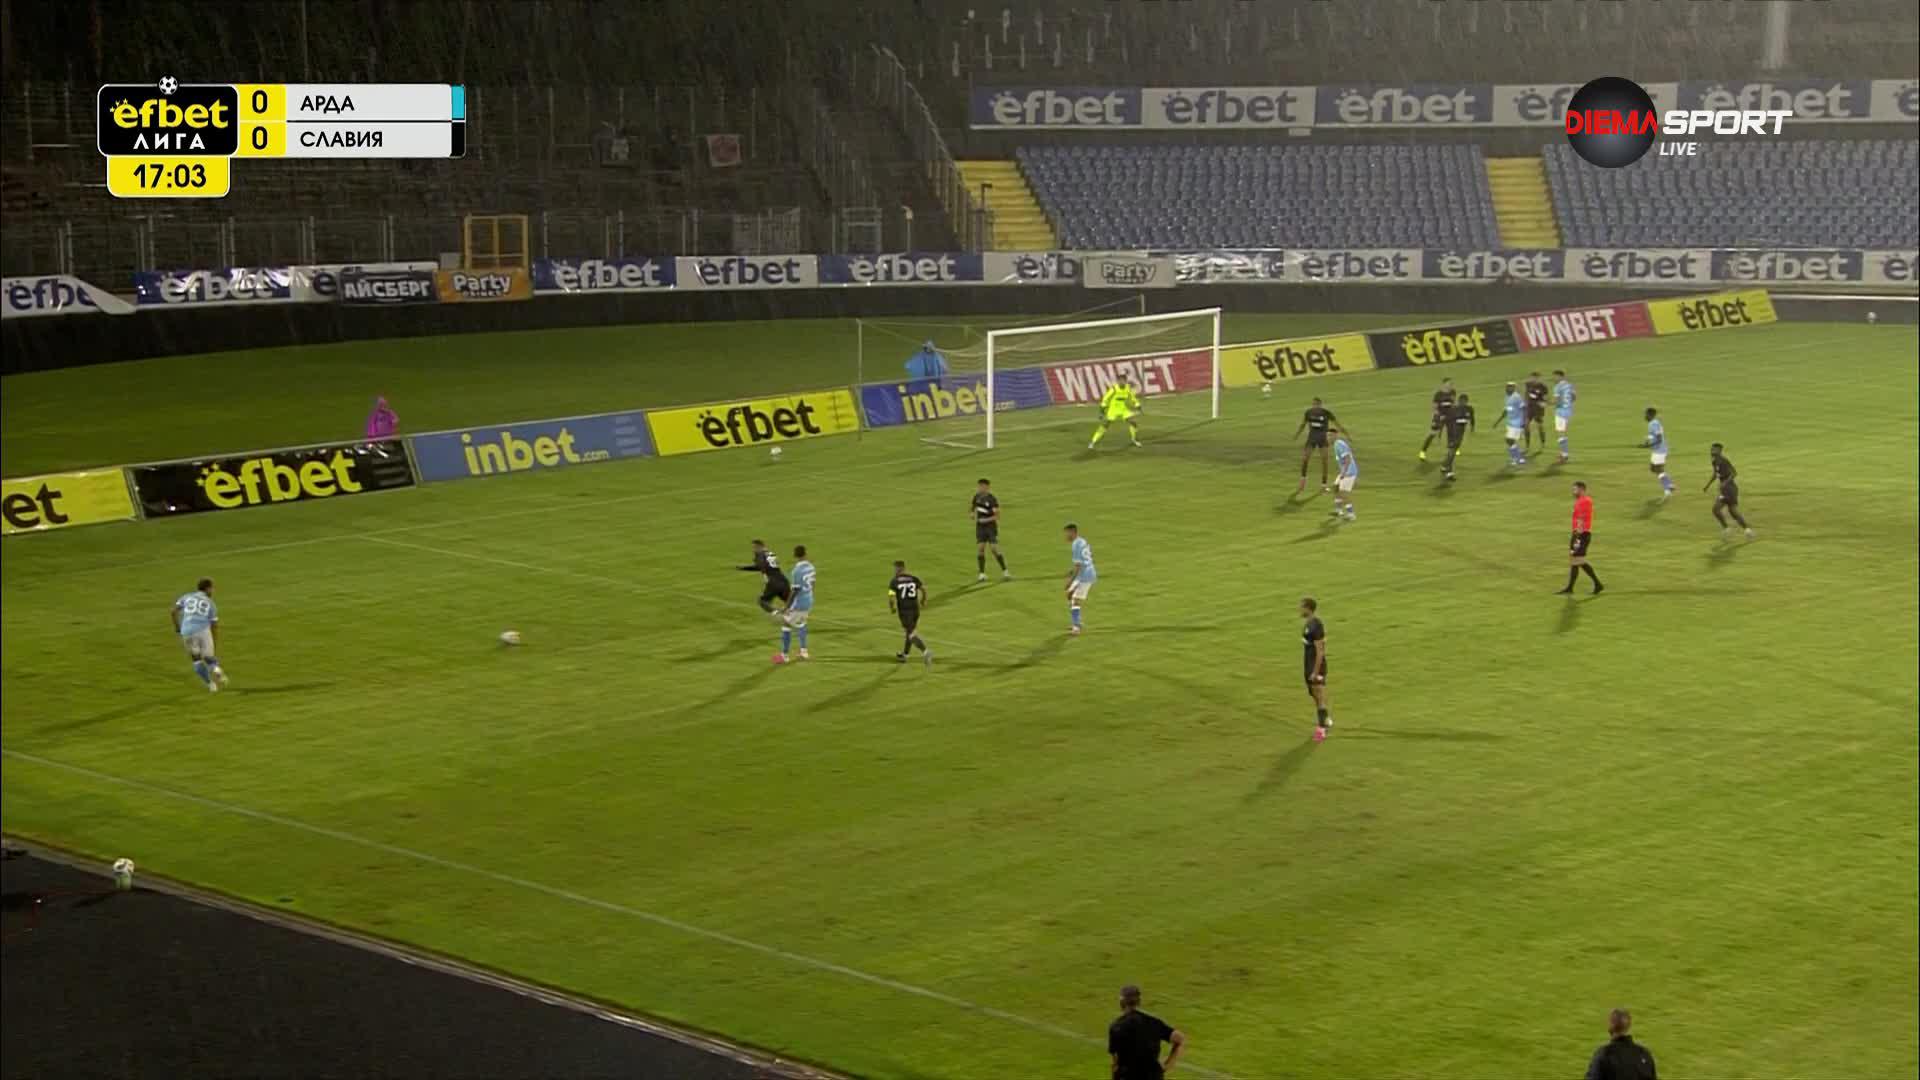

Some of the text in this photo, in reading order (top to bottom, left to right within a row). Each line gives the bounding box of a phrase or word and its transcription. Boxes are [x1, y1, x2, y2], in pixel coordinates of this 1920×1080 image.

[992, 90, 1126, 124] efbet
[1164, 90, 1298, 124] efbet
[1337, 88, 1476, 123] efbet
[554, 259, 661, 288] efbet
[702, 258, 801, 286] efbet
[852, 252, 956, 281] efbet
[1302, 251, 1411, 279] efbet
[1439, 250, 1552, 278] efbet
[1584, 251, 1698, 280] efbet
[1733, 250, 1850, 281] efbet
[344, 279, 431, 299] АЙСБЕРГ
[453, 273, 511, 293] Party
[1519, 308, 1618, 348] WINBET
[1680, 297, 1753, 330] efbet
[1256, 343, 1341, 381] efbet
[1403, 326, 1491, 366] efbet
[1054, 357, 1177, 402] WINBET
[700, 398, 821, 447] efbet
[202, 449, 362, 510] efbet
[897, 582, 917, 599] 73
